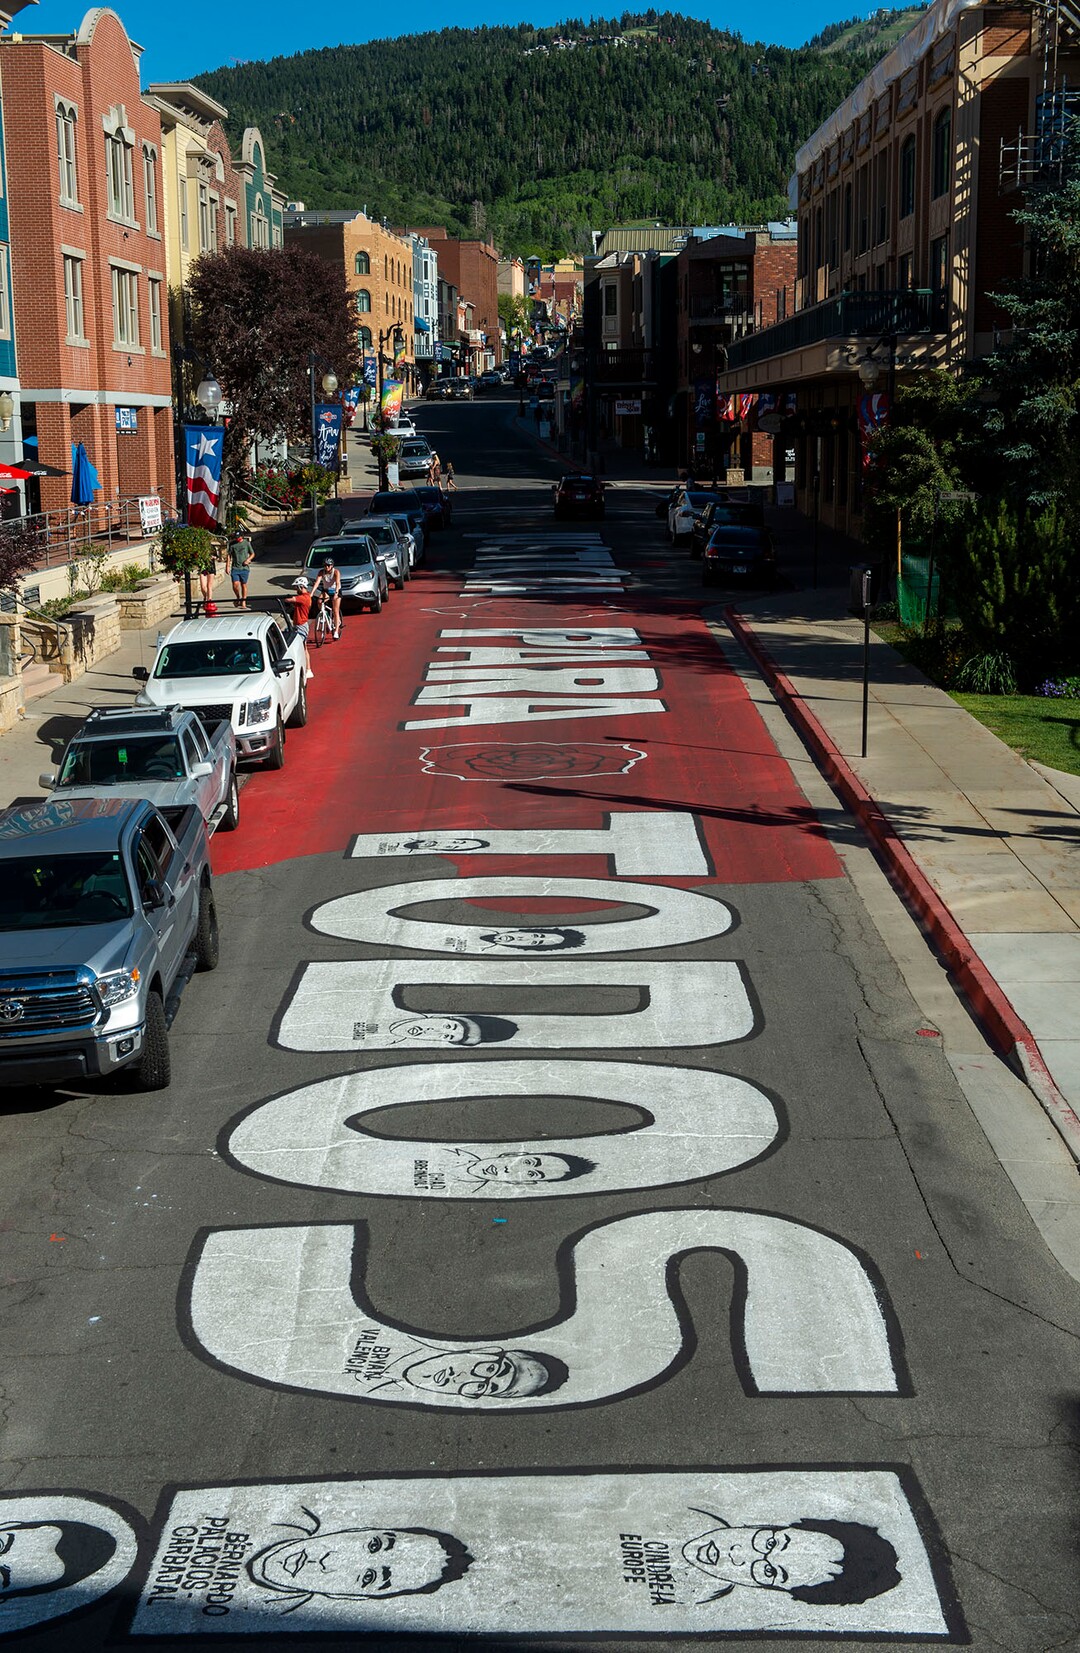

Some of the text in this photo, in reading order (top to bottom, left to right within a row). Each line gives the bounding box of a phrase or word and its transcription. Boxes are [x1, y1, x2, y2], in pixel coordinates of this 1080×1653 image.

[404, 627, 667, 731] PARA
[342, 1328, 381, 1374] VALENCIA
[364, 1345, 391, 1380] BRYAN
[146, 1526, 198, 1606] CARBAJAL
[202, 1532, 250, 1616] BERNARDO
[619, 1533, 647, 1583] EUROPE
